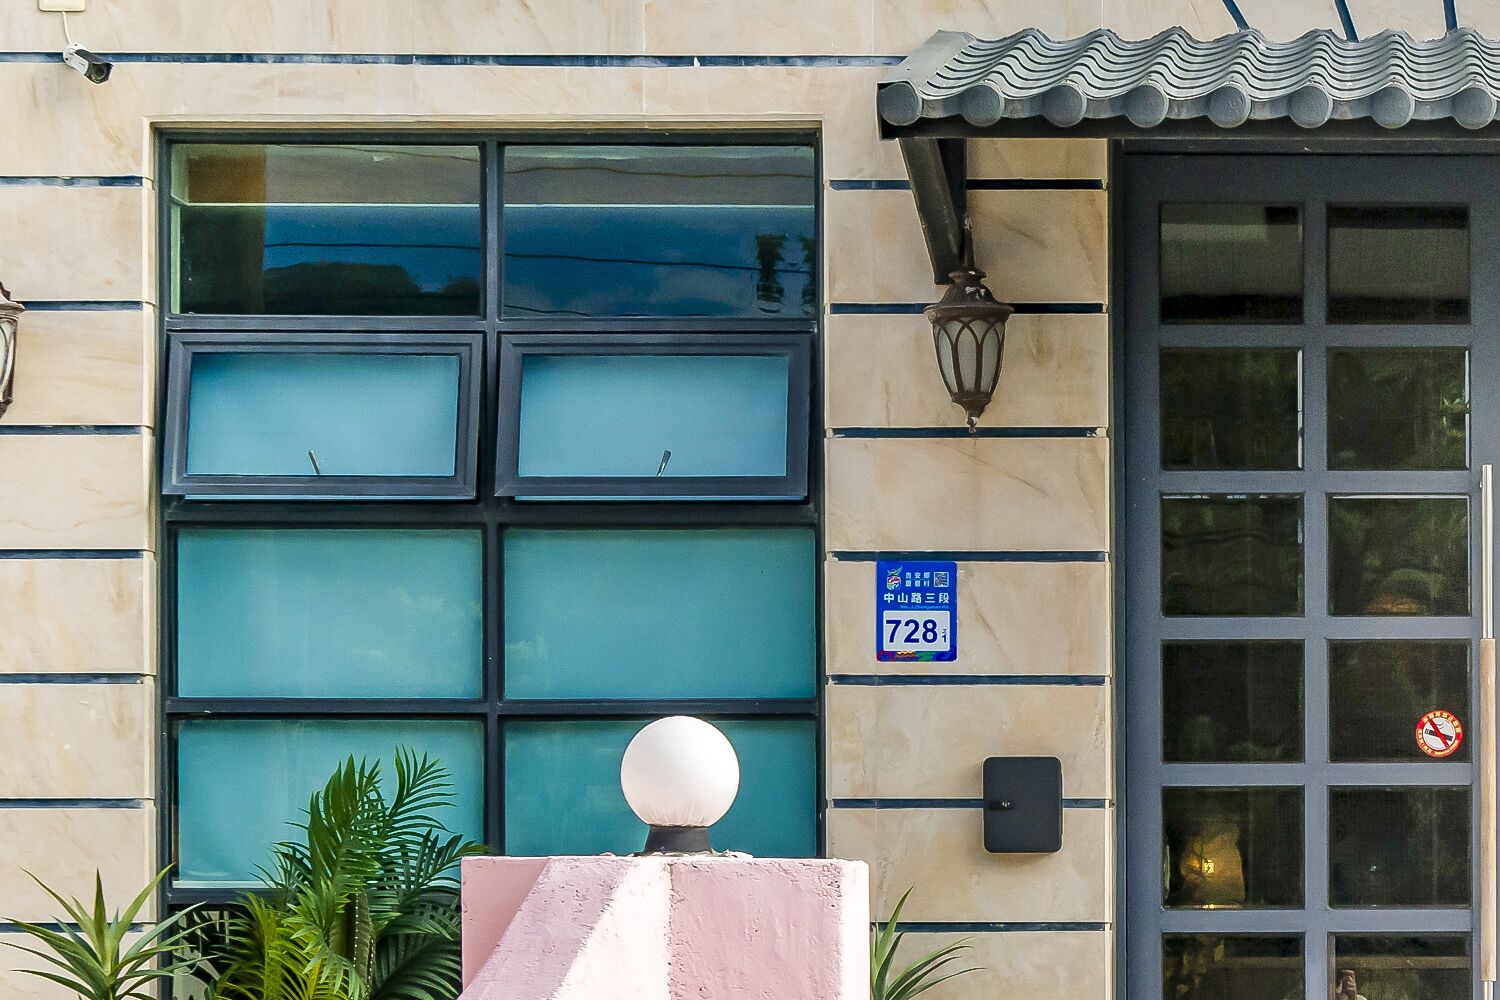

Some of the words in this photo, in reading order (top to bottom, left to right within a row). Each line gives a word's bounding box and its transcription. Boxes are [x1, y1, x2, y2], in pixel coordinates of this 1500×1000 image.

[883, 592, 950, 604] 中山路三段
[885, 618, 938, 644] 728
